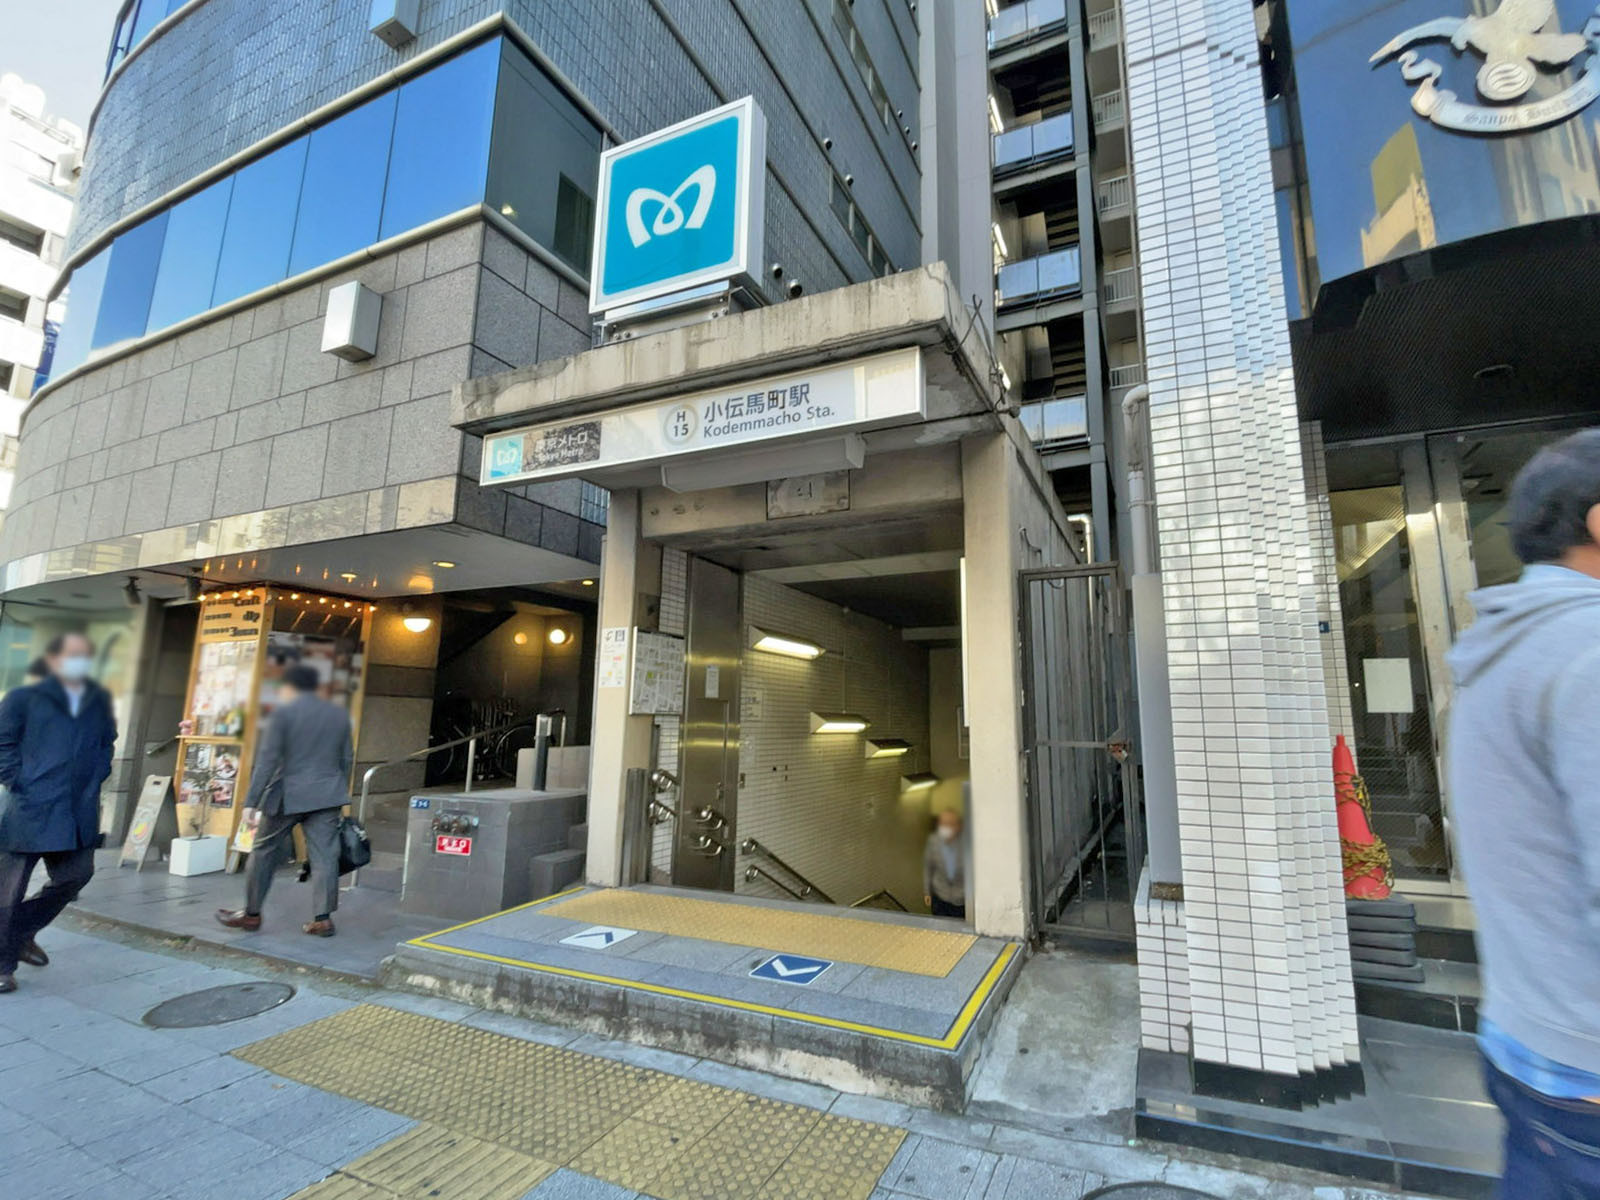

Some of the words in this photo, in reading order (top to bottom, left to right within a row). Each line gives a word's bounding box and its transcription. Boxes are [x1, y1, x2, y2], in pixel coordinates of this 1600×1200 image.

[704, 383, 810, 423] 小伝馬町駅
[676, 411, 686, 423] H
[704, 411, 801, 438] Kodemmacho
[806, 405, 835, 421] Sta.
[673, 424, 689, 437] 15
